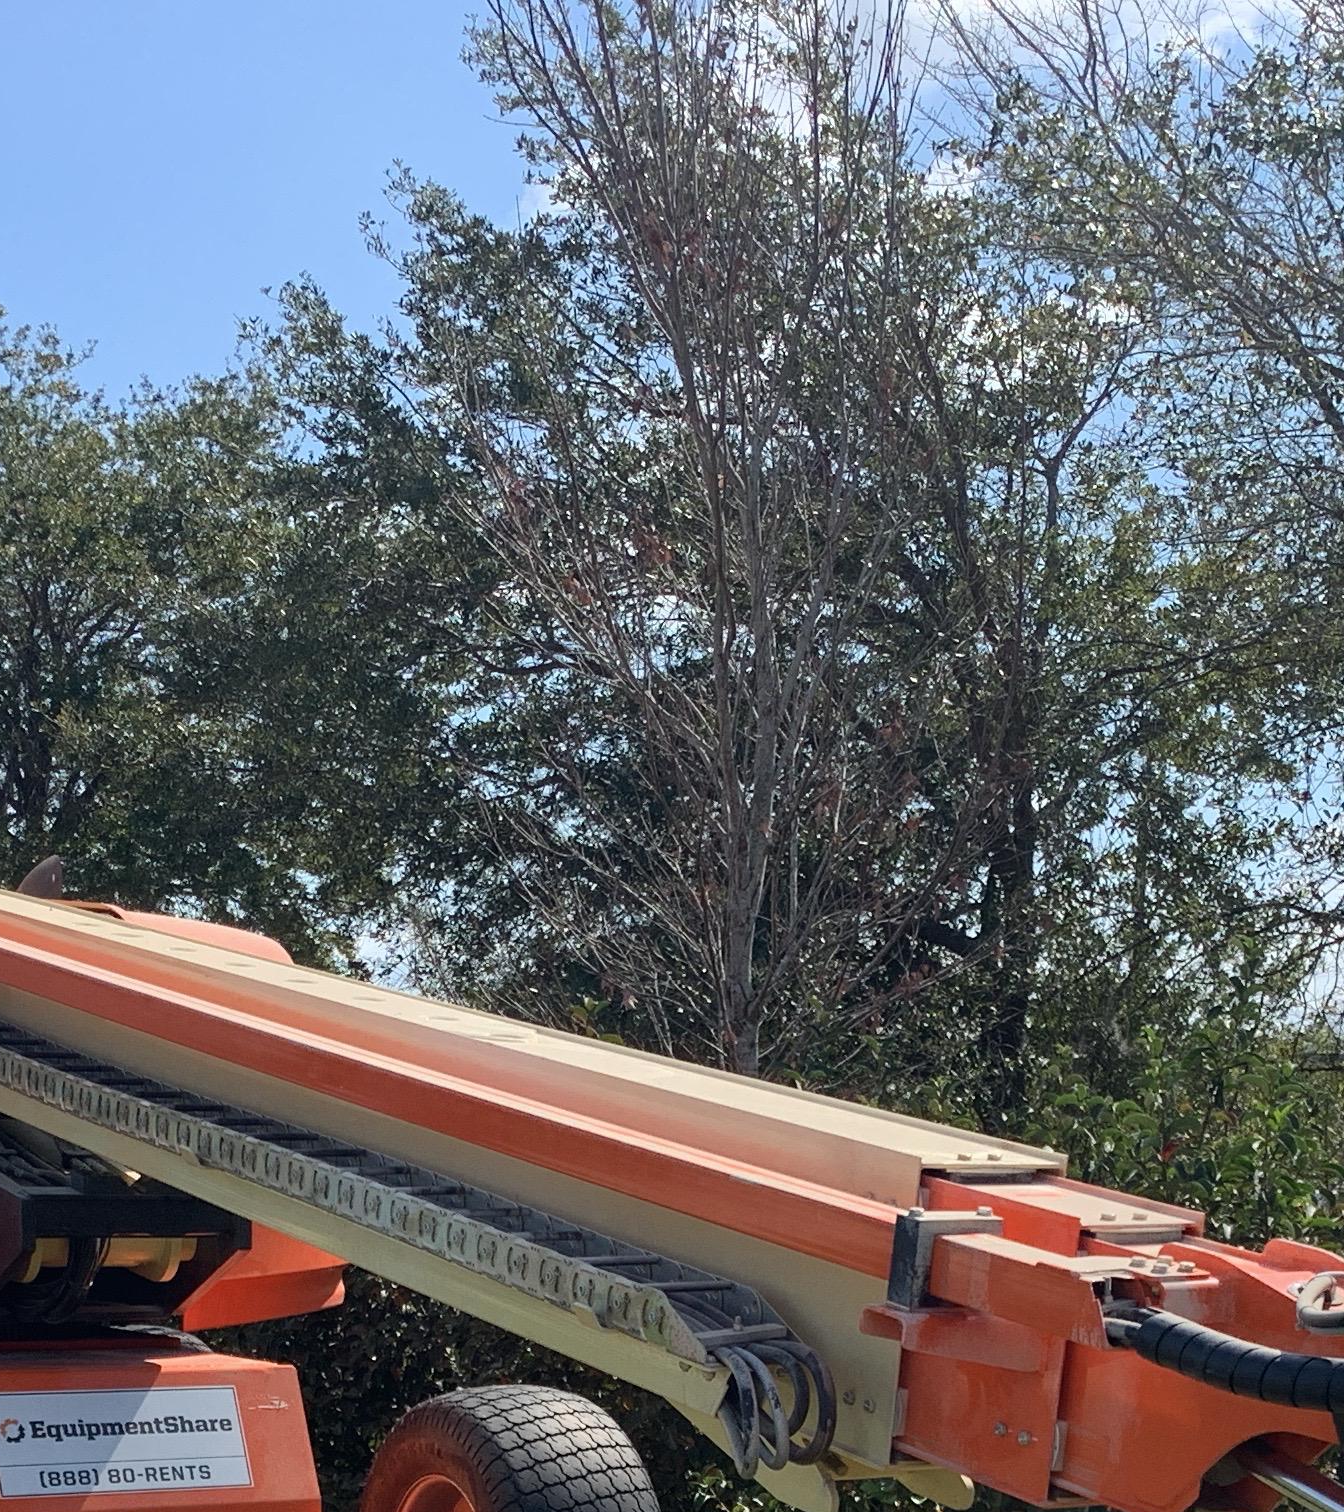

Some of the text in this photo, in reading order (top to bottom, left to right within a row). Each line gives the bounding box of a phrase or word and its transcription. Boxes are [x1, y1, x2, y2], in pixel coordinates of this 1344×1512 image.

[29, 1415, 233, 1442] EquipmentShare
[40, 1465, 211, 1488] (888) 80-RENTS
